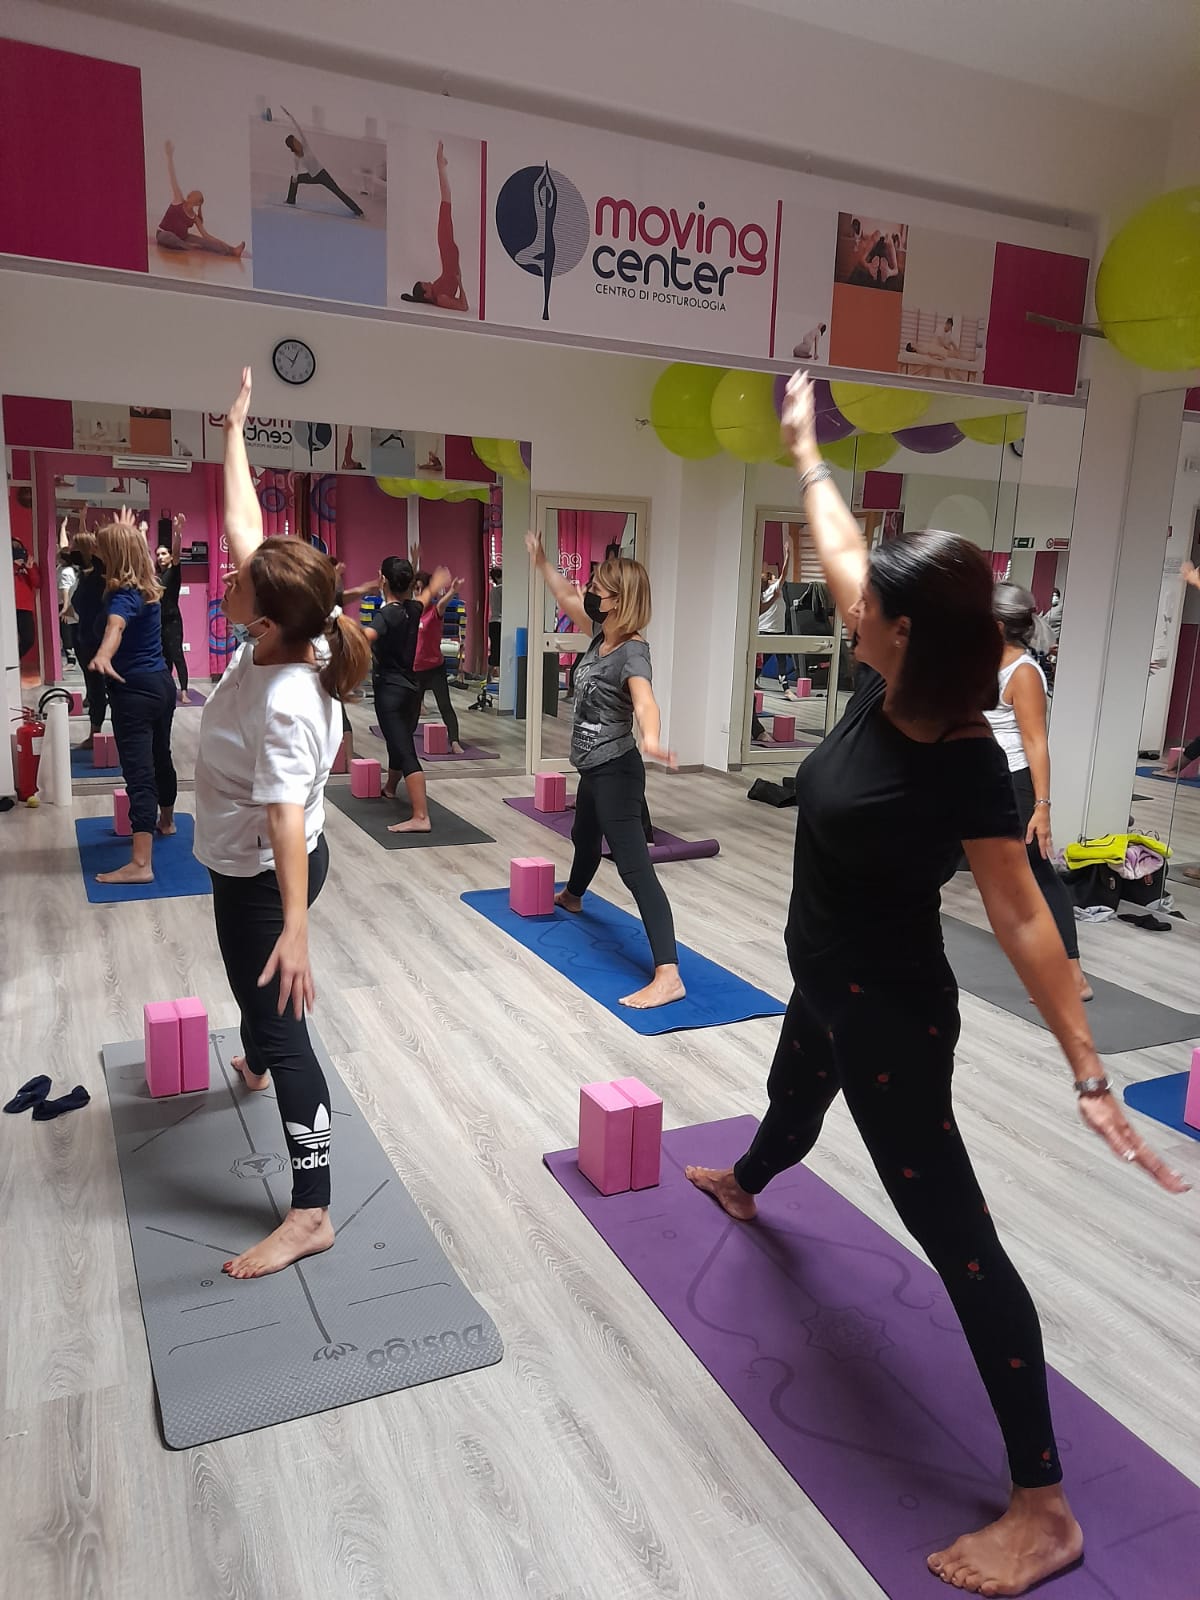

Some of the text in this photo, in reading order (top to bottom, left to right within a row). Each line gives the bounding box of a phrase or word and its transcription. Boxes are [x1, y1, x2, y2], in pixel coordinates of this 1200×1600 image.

[595, 196, 768, 276] moving
[592, 245, 734, 297] center
[595, 283, 727, 312] CENTRO DI POSTUROLOGIA
[292, 1149, 330, 1170] adid
